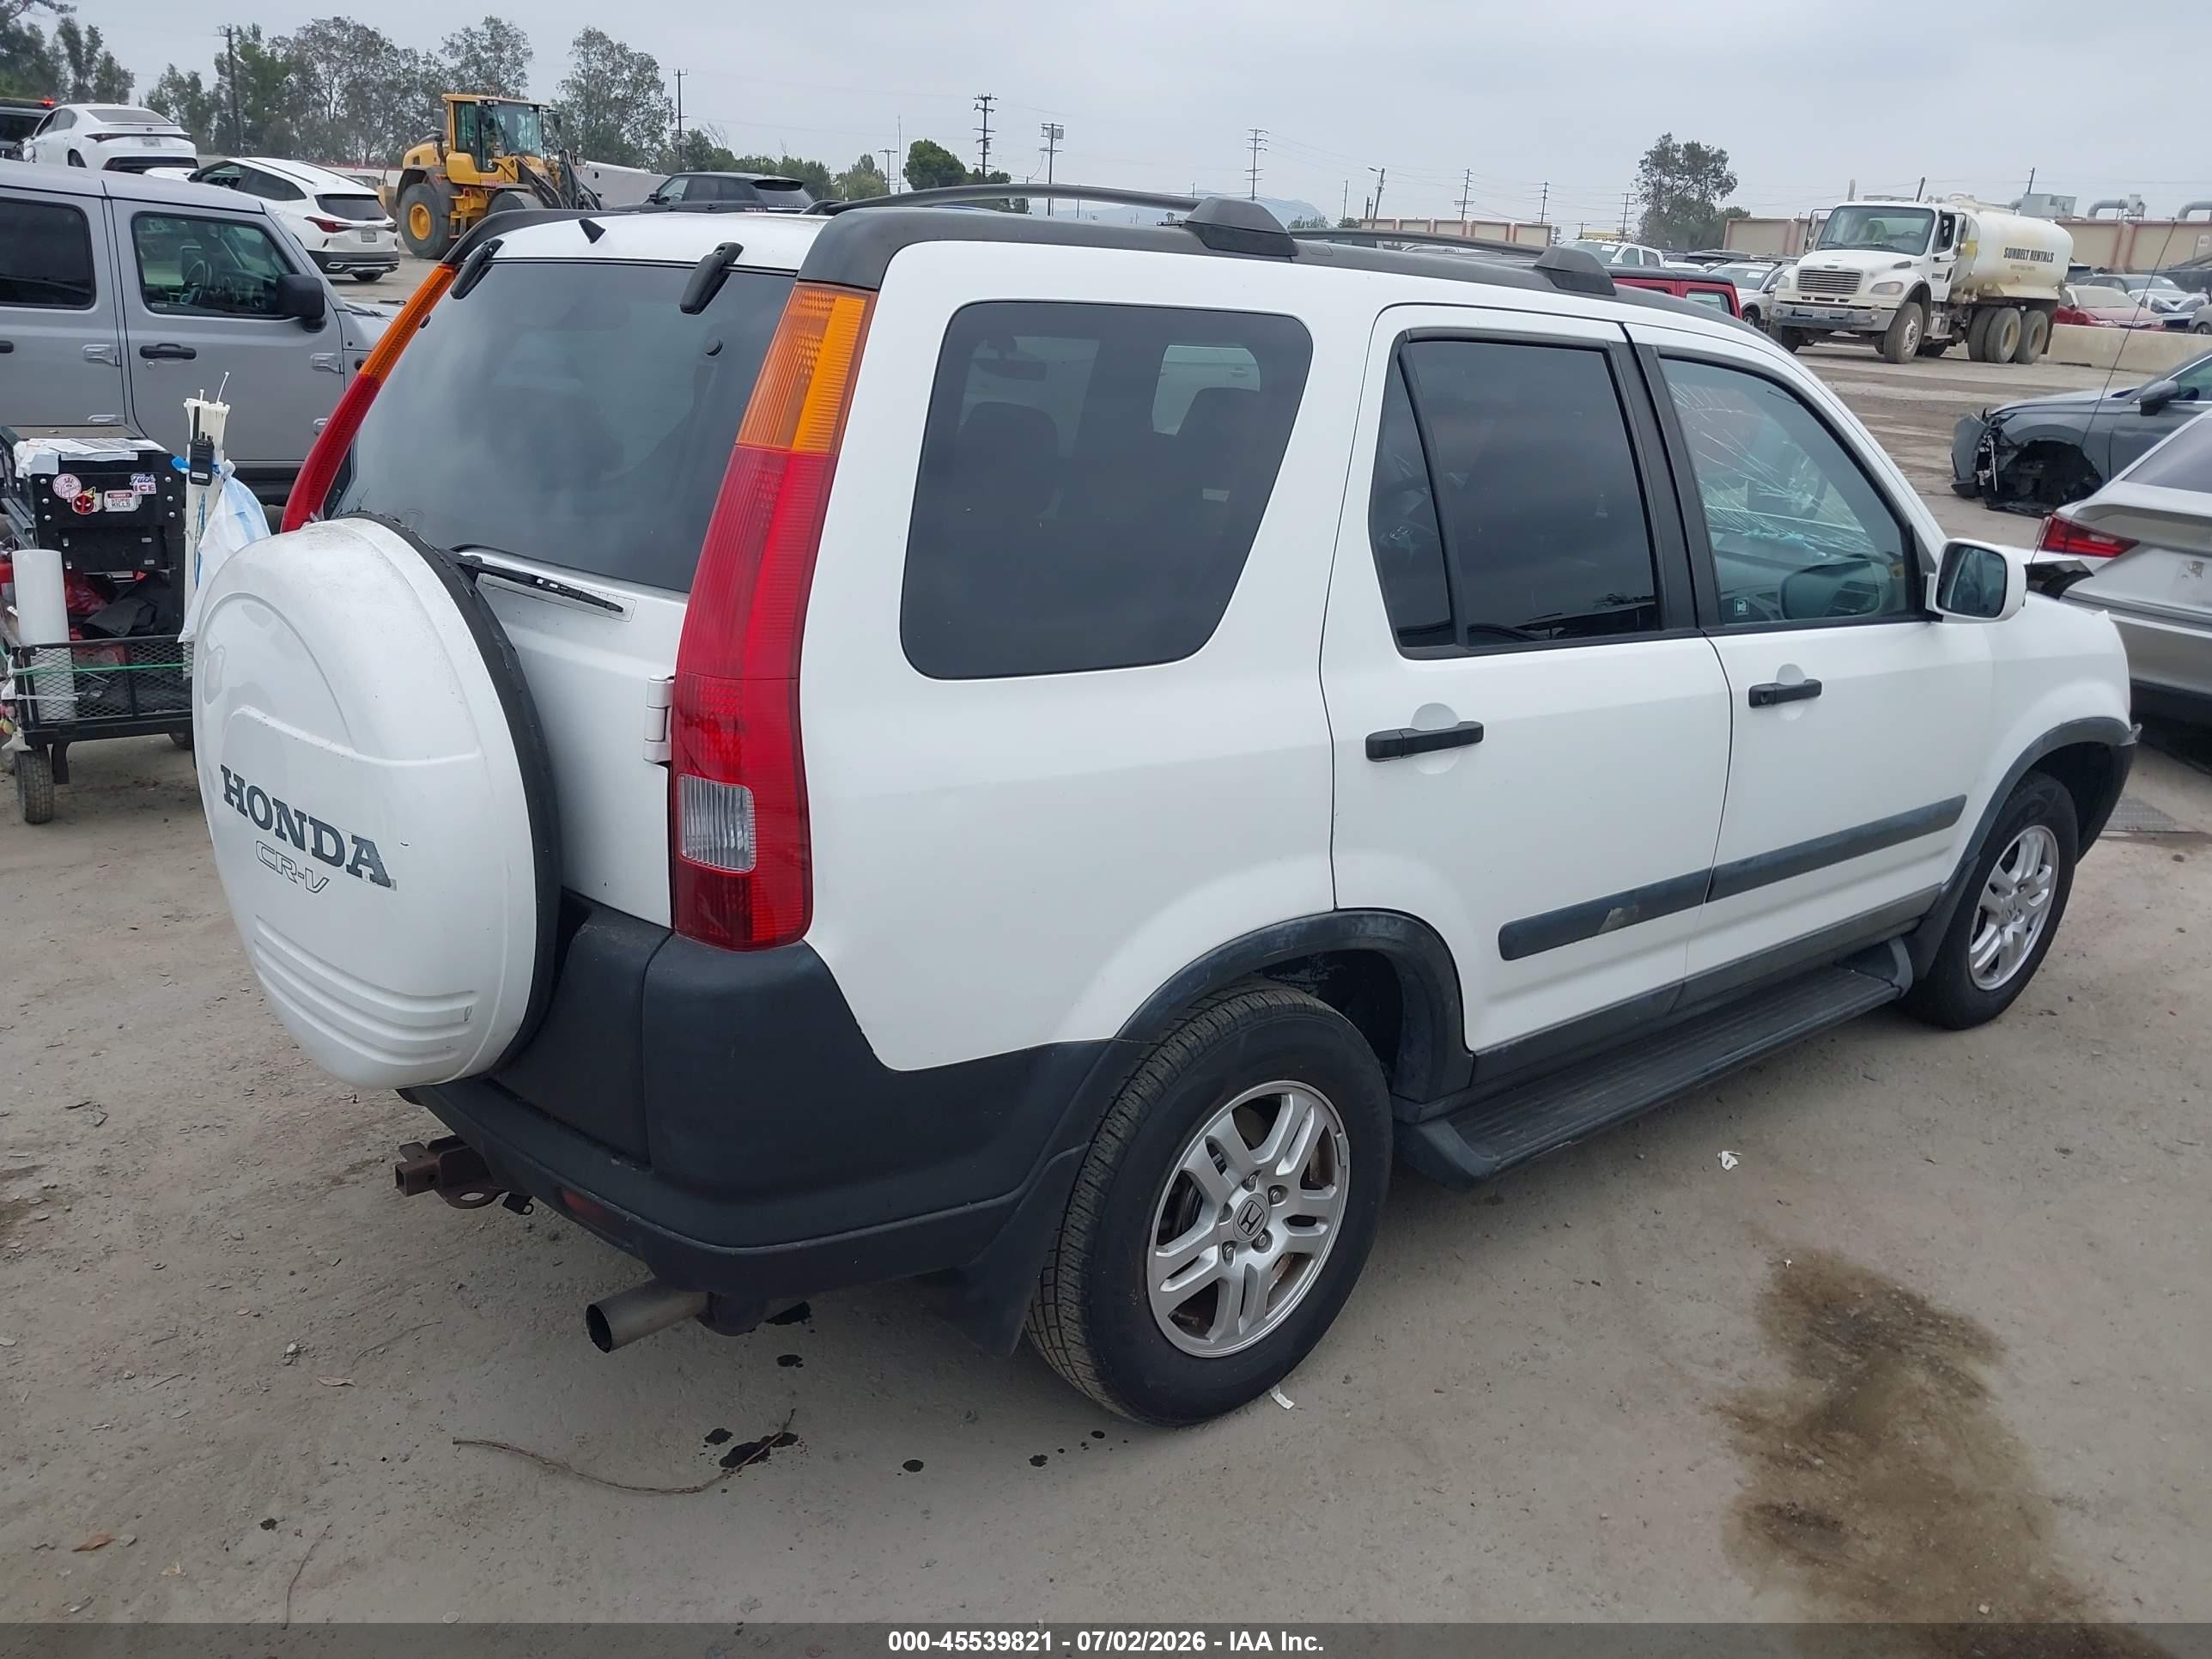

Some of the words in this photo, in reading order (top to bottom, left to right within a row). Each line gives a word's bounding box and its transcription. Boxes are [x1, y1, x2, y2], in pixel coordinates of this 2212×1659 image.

[2003, 247, 2030, 261] SUNBELT
[2029, 250, 2054, 263] RENTALS
[134, 484, 155, 493] ICE
[220, 763, 392, 888] HONDA
[256, 840, 330, 893] CR-V
